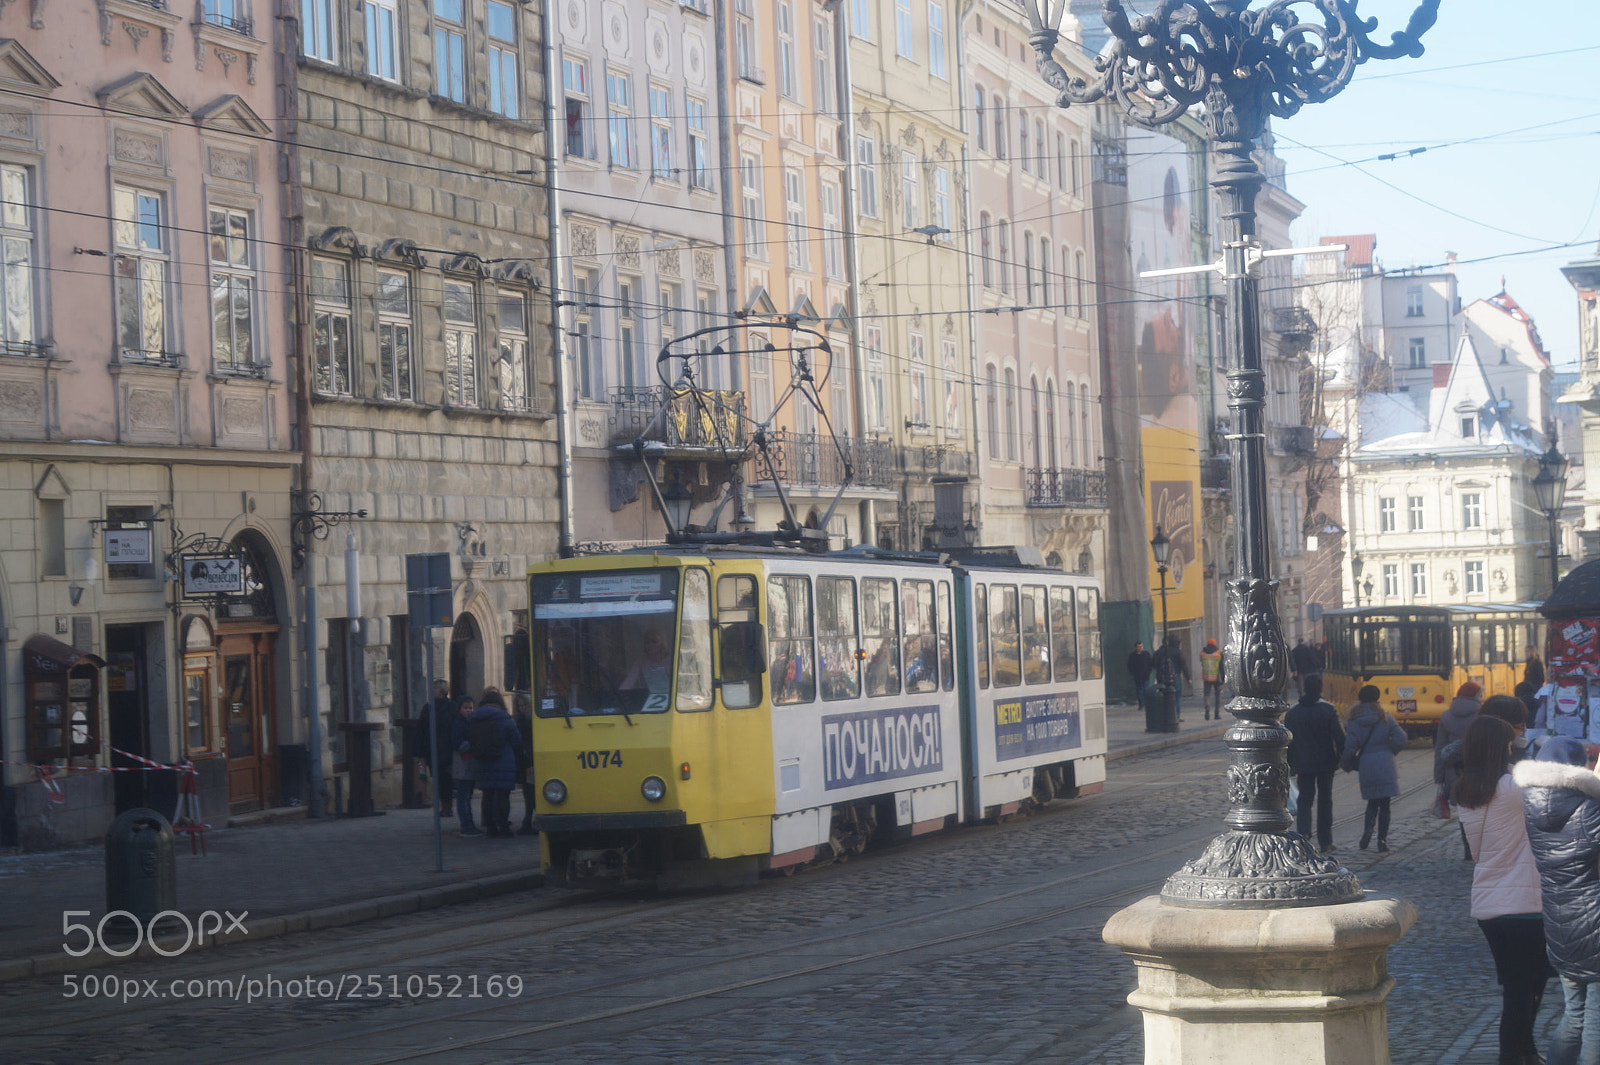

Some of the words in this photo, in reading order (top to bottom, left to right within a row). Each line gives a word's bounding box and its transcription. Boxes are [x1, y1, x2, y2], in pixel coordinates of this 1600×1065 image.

[997, 703, 1022, 725] METRO
[825, 712, 940, 781] ПОЧАЛОСЯ!
[577, 750, 623, 769] 1074
